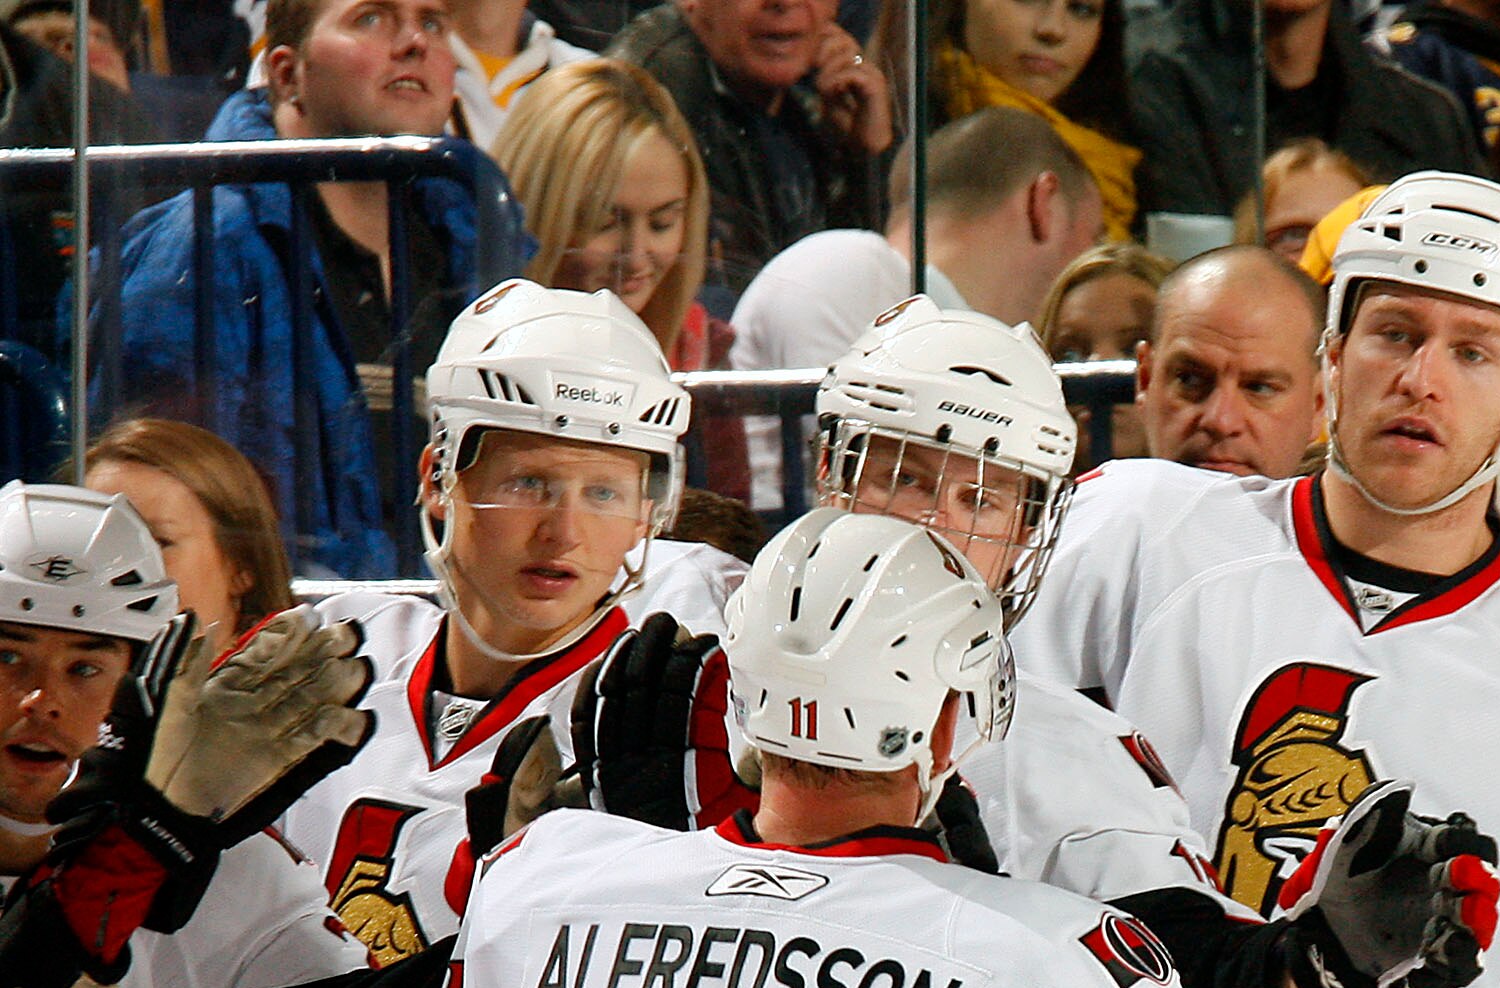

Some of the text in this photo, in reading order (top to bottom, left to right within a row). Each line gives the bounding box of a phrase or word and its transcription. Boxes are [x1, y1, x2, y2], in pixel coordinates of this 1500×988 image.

[1428, 232, 1490, 254] CCM
[556, 382, 624, 406] Reebok
[936, 400, 1015, 427] BAUER
[787, 696, 819, 741] 11
